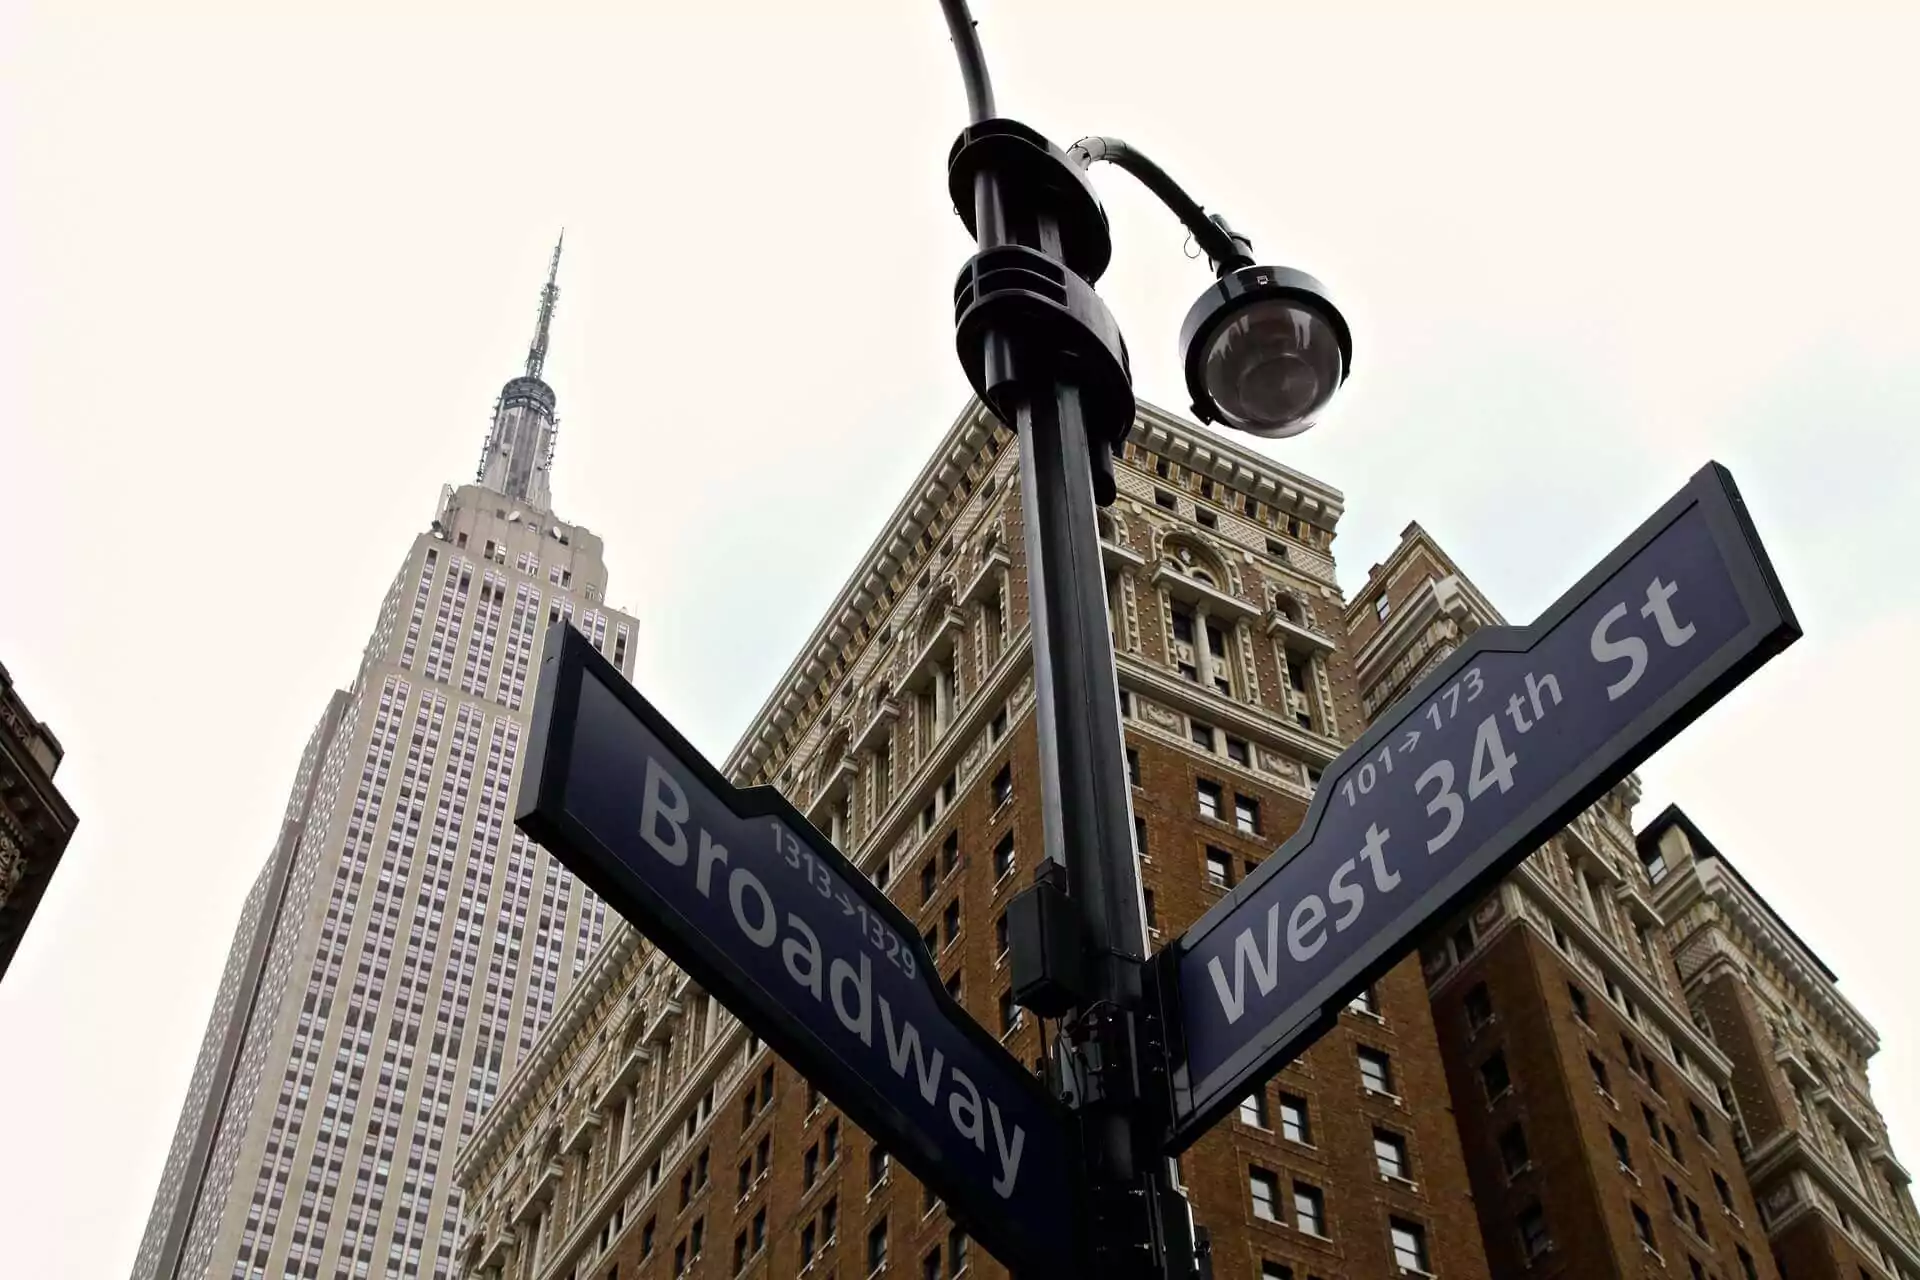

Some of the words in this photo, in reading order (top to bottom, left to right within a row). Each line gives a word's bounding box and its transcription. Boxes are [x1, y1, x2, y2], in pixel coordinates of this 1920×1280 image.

[1206, 822, 1402, 1025] West
[1414, 673, 1563, 855] 34th
[1590, 576, 1698, 702] St
[1341, 754, 1395, 807] 101
[1425, 667, 1485, 732] 173
[639, 757, 1026, 1199] Broadway
[771, 822, 832, 899] 1313
[858, 908, 917, 979] 1329
